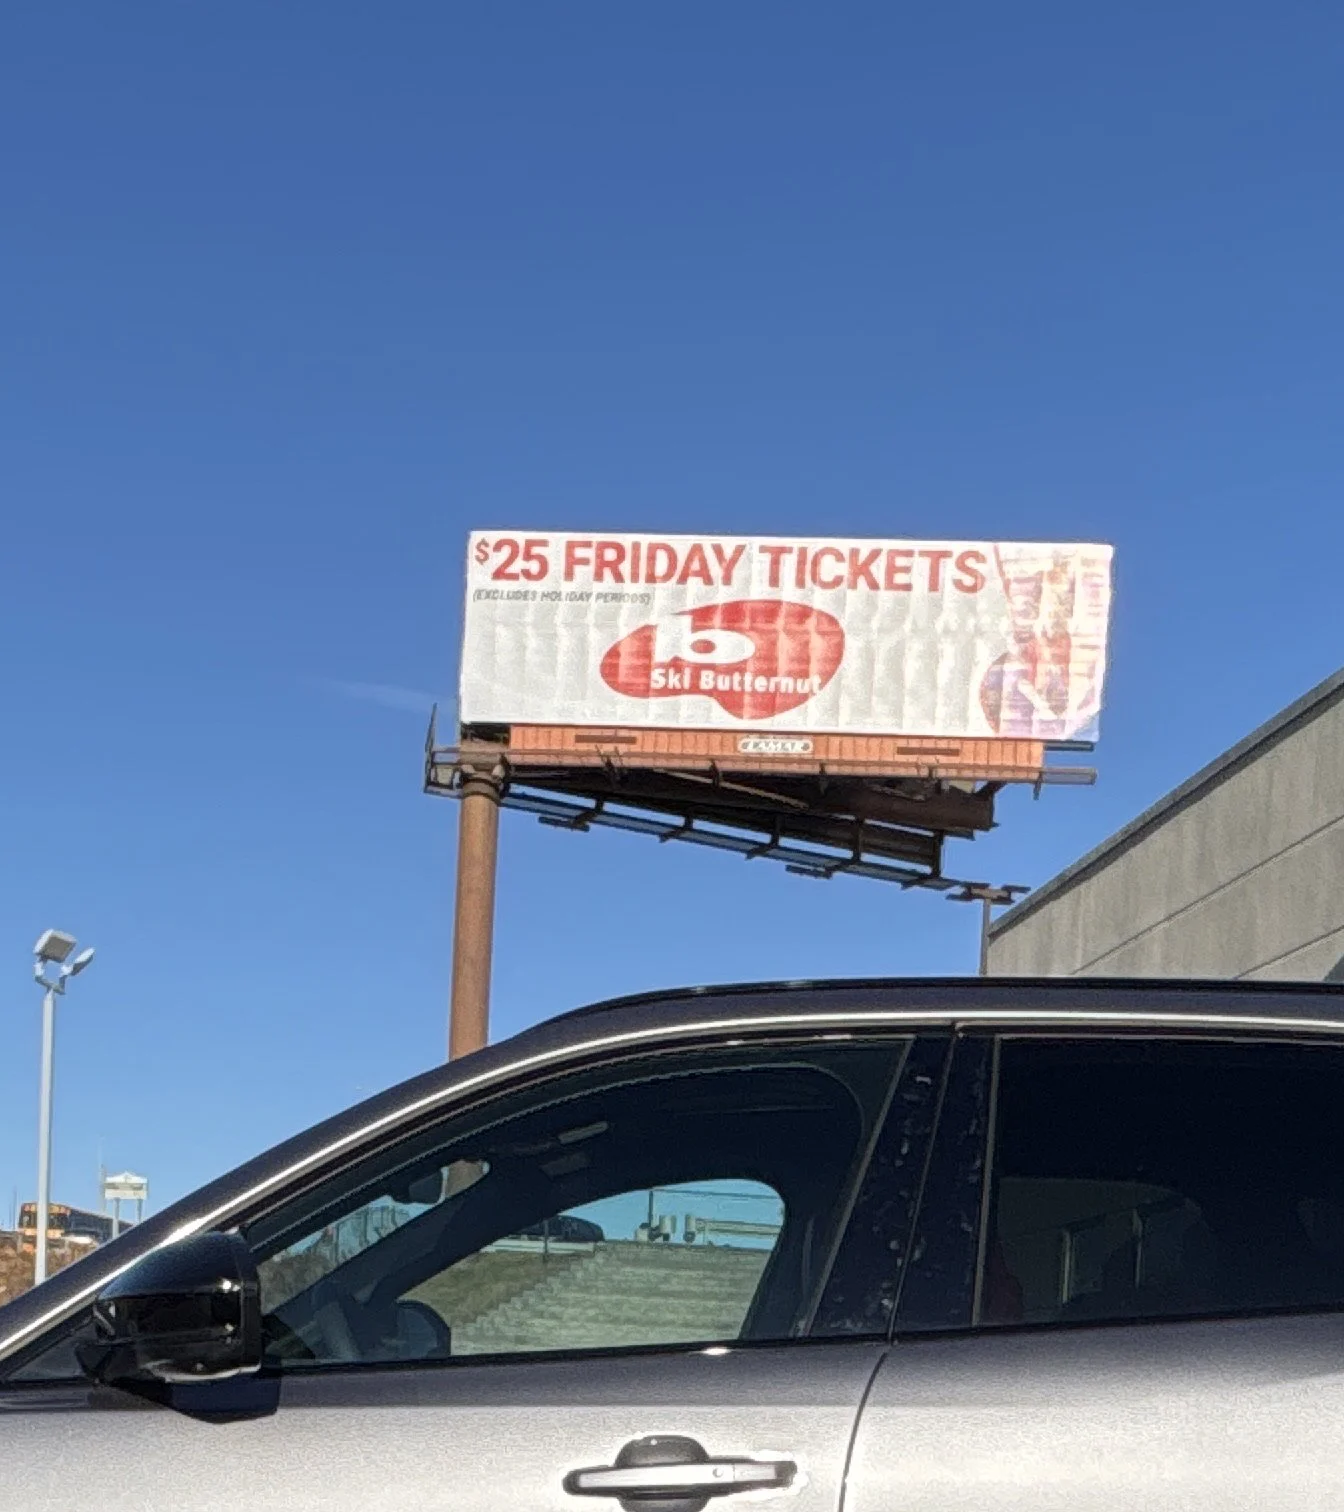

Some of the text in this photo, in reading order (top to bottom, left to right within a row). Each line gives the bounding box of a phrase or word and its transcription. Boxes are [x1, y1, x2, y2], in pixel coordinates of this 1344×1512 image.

[474, 538, 987, 594] $25 FRIDAY TICKETS
[473, 587, 651, 605] (EXCLUDES HOLIDAY PERIODS)
[650, 668, 822, 694] Ski Butternut
